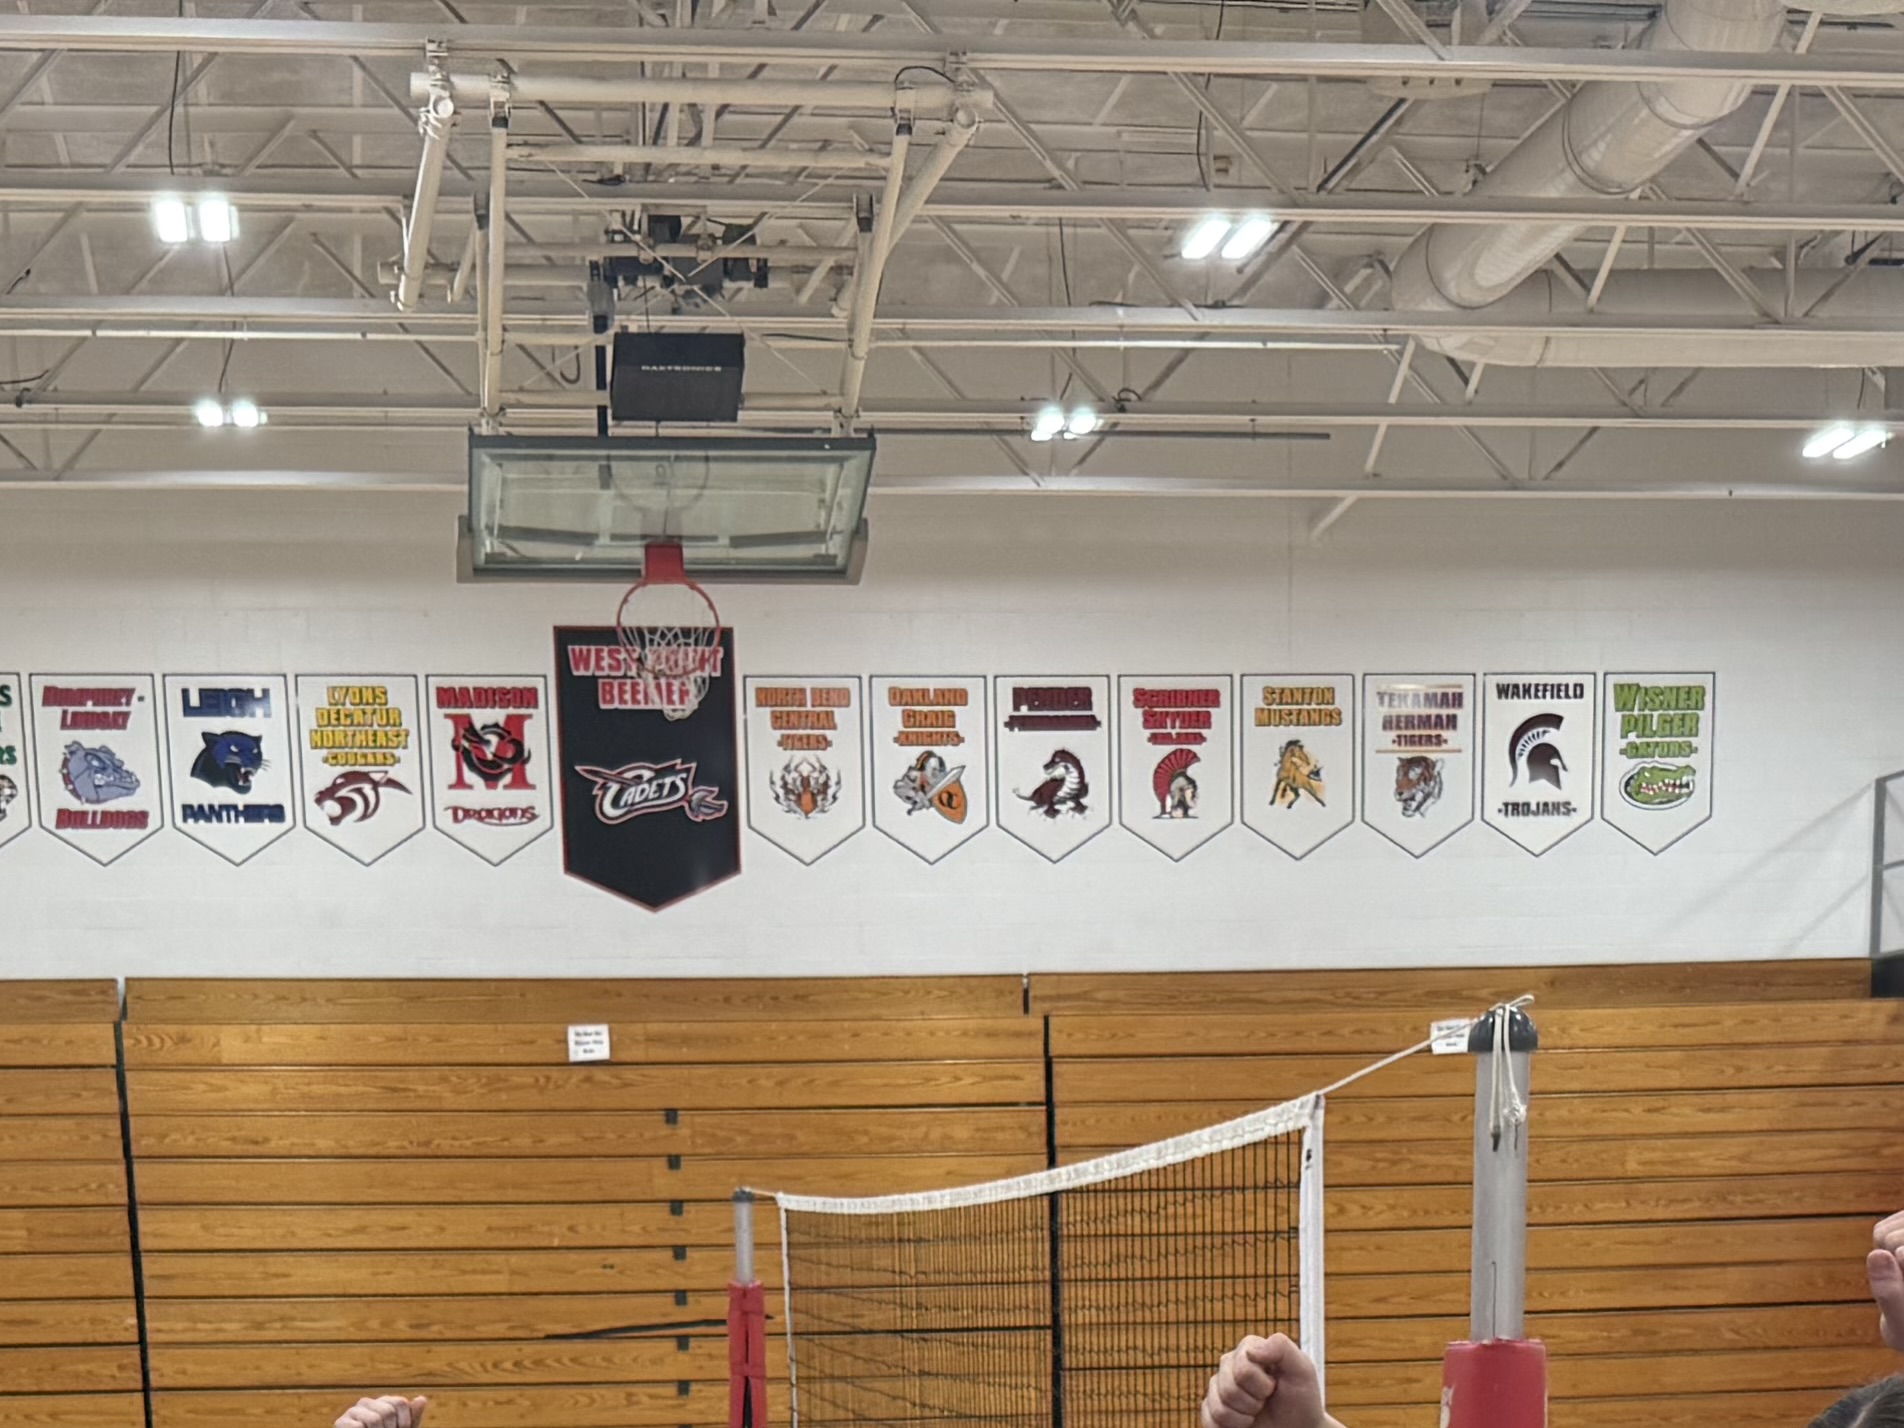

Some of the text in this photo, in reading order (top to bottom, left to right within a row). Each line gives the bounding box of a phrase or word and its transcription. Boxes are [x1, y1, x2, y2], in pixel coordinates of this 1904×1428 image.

[327, 686, 388, 706] LYONS
[436, 686, 538, 709] MADISON
[888, 686, 968, 706] OAKLAND
[1263, 686, 1335, 705] STANTON
[1376, 691, 1463, 709] TEKAMAH
[1496, 683, 1584, 700] WAKEFIELD
[1613, 683, 1706, 711] WISNER
[181, 688, 272, 718] LEIGH
[316, 708, 402, 728] DECATUR
[770, 710, 837, 730] CENTRAL
[901, 709, 956, 728] CRAIG
[1254, 708, 1342, 727] MUSTANGS
[1382, 714, 1457, 731] HERMAN
[1620, 713, 1700, 739] PILGER
[310, 729, 409, 749] NORTHEAST
[182, 804, 286, 824] PANTHERS
